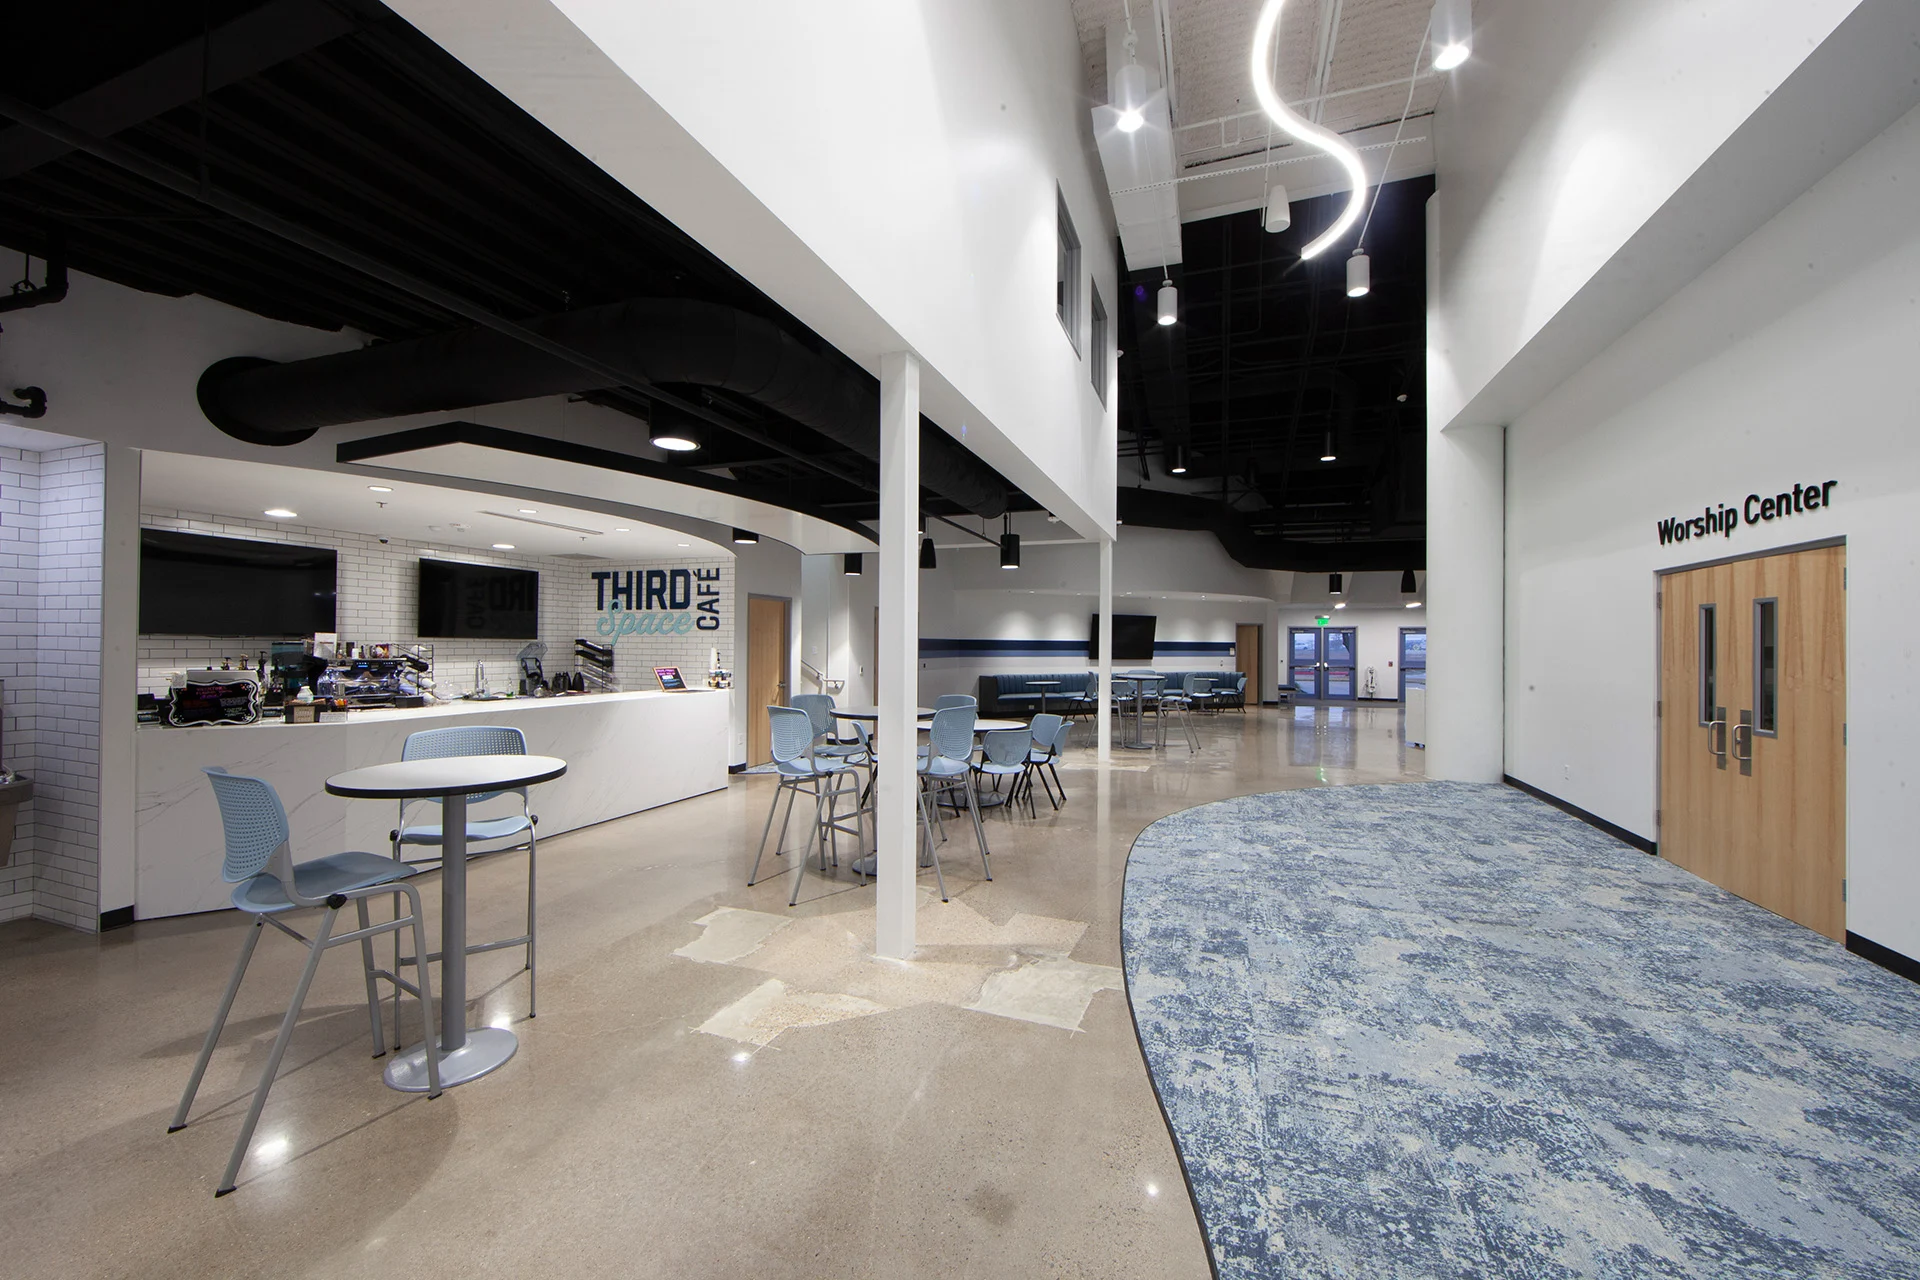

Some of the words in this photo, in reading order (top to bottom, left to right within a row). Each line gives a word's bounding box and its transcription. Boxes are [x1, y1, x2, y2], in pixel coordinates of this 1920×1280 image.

[1657, 503, 1738, 546] Worship
[1744, 480, 1838, 525] Center
[591, 569, 691, 610] THIRD
[693, 567, 720, 630] CAFÉ
[596, 598, 695, 646] Space
